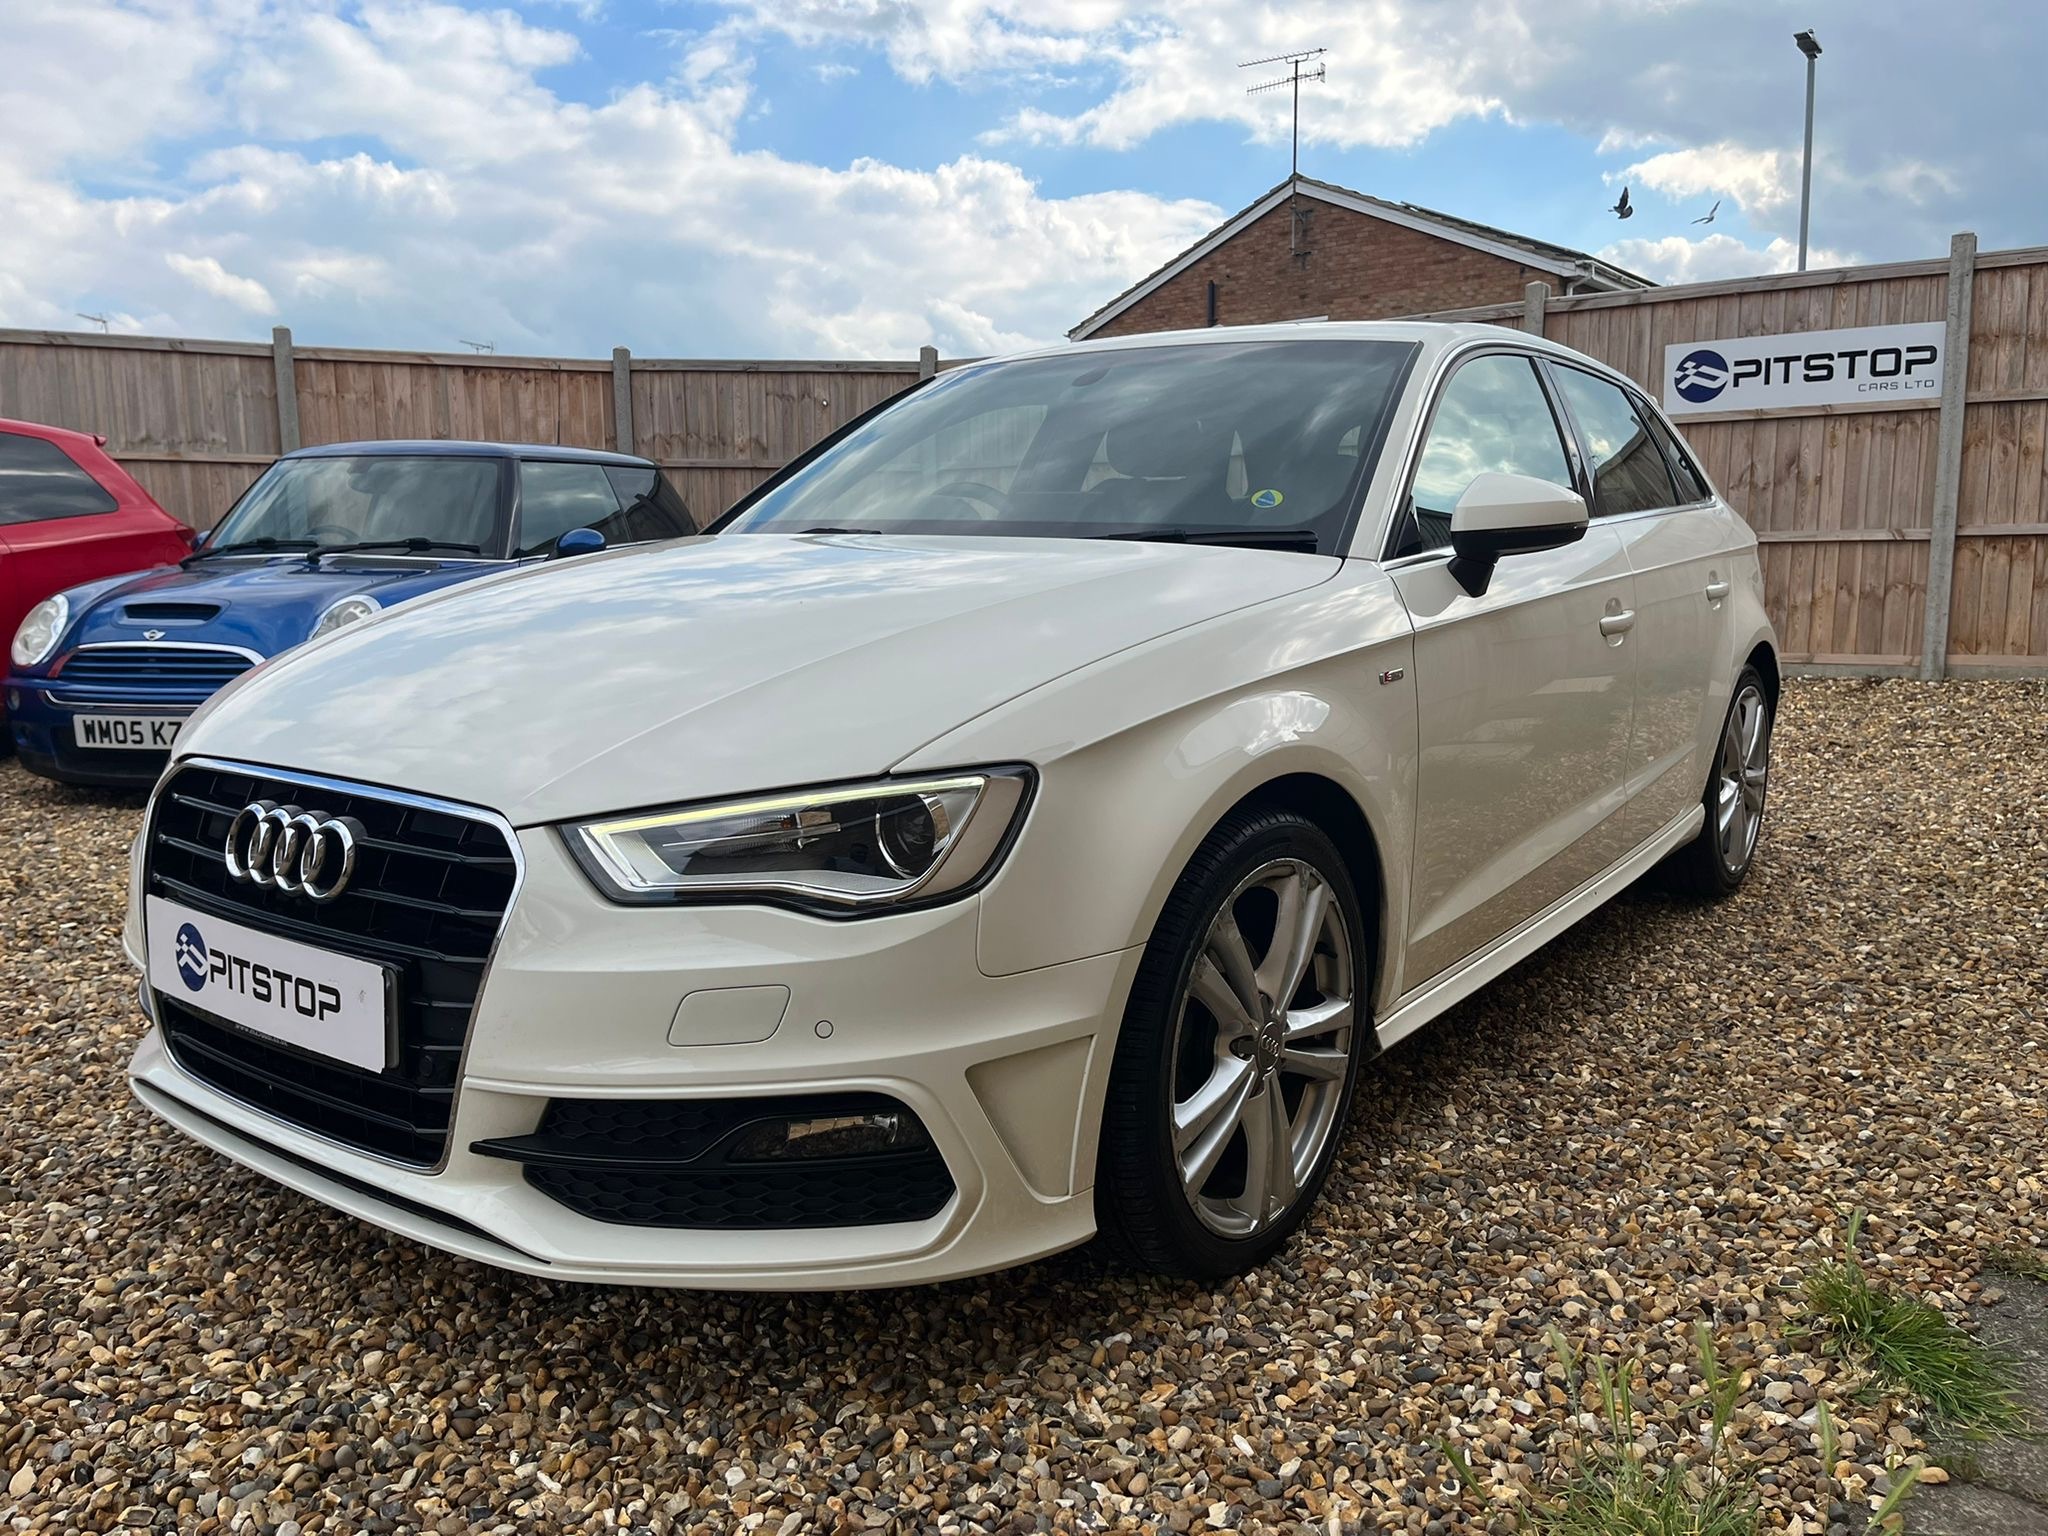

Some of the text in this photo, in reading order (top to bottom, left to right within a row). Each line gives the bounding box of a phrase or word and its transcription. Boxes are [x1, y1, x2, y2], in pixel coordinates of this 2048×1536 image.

[1732, 345, 1938, 388] PITSTOP
[1858, 381, 1899, 392] CARS
[82, 719, 145, 745] WM05
[209, 948, 341, 1021] PITSTOP
